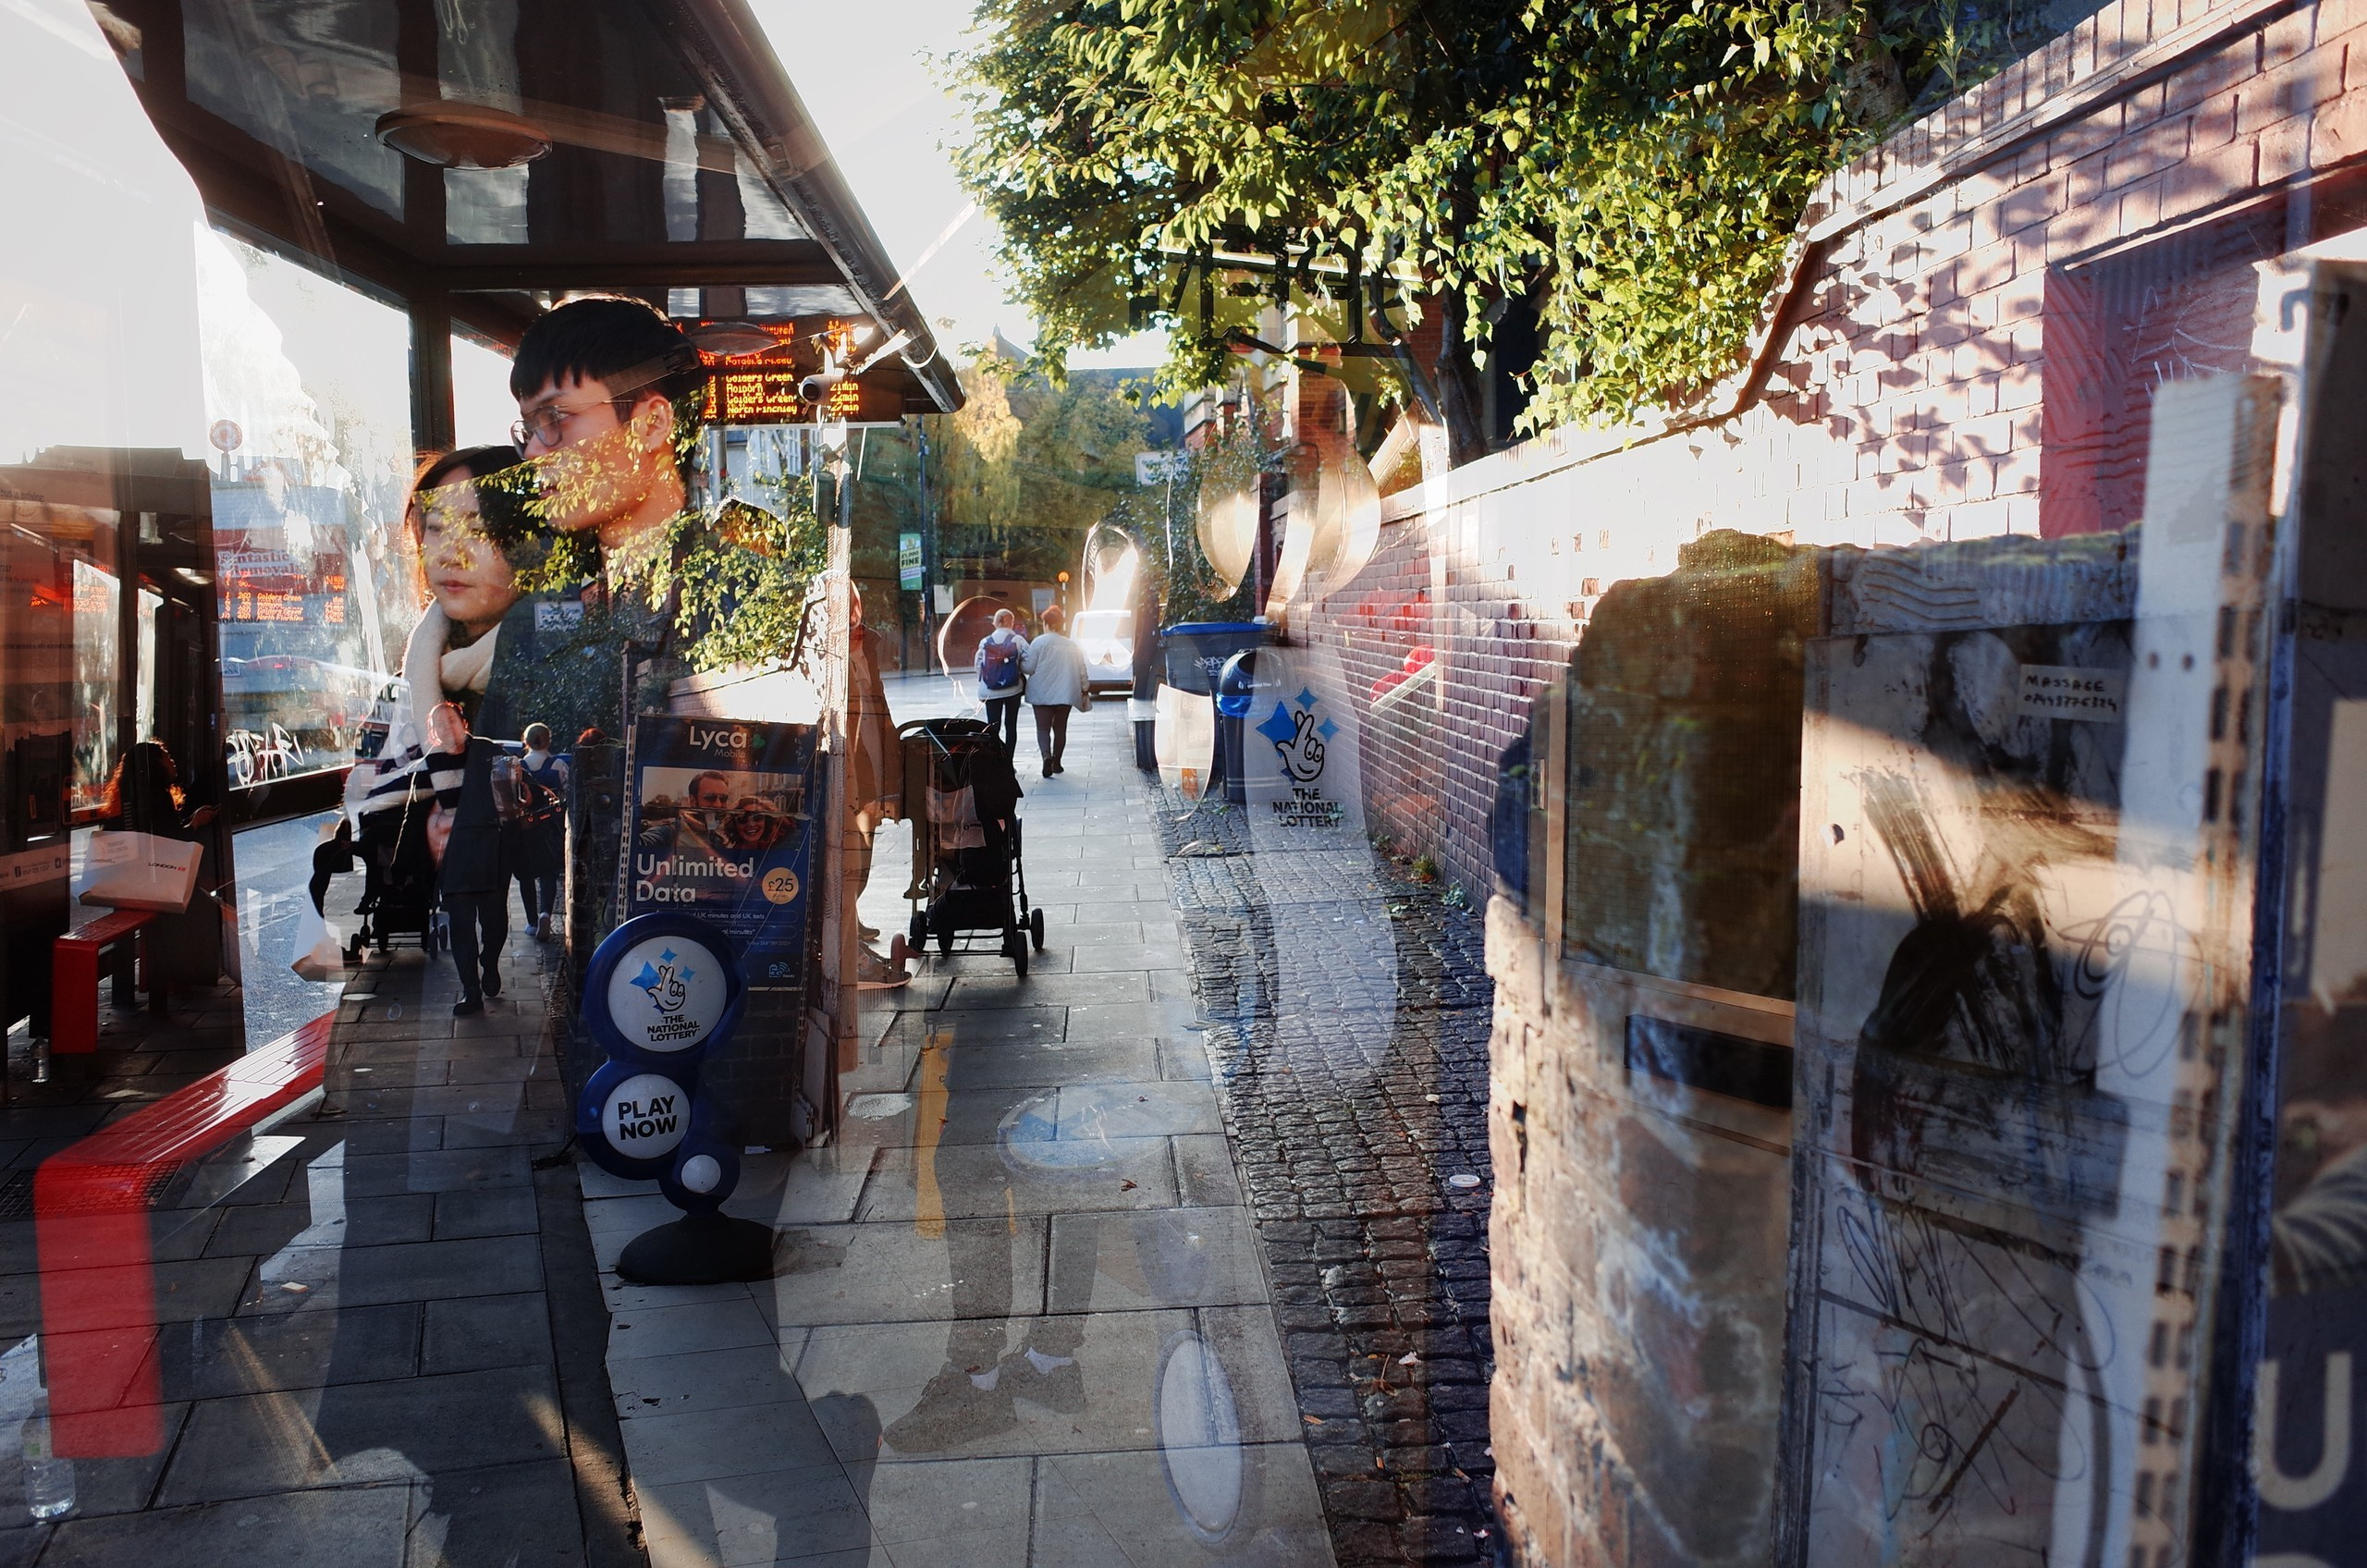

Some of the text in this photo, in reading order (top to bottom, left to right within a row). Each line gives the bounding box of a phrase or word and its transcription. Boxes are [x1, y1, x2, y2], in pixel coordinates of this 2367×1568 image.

[901, 557, 920, 567] FINE
[2025, 675, 2104, 692] MASSAGE
[689, 726, 748, 751] Lyca
[1292, 788, 1320, 801] THE
[1272, 801, 1343, 815] NATIONAL
[1279, 815, 1342, 828] LOTTERY
[636, 853, 755, 878] Unlimited
[635, 880, 696, 903] Data
[767, 877, 794, 892] £25
[662, 1014, 685, 1024] THE
[647, 1021, 701, 1034] NATIONAL
[650, 1030, 697, 1042] LOTTERY
[618, 1095, 676, 1121] PLAY
[619, 1115, 678, 1141] NOW
